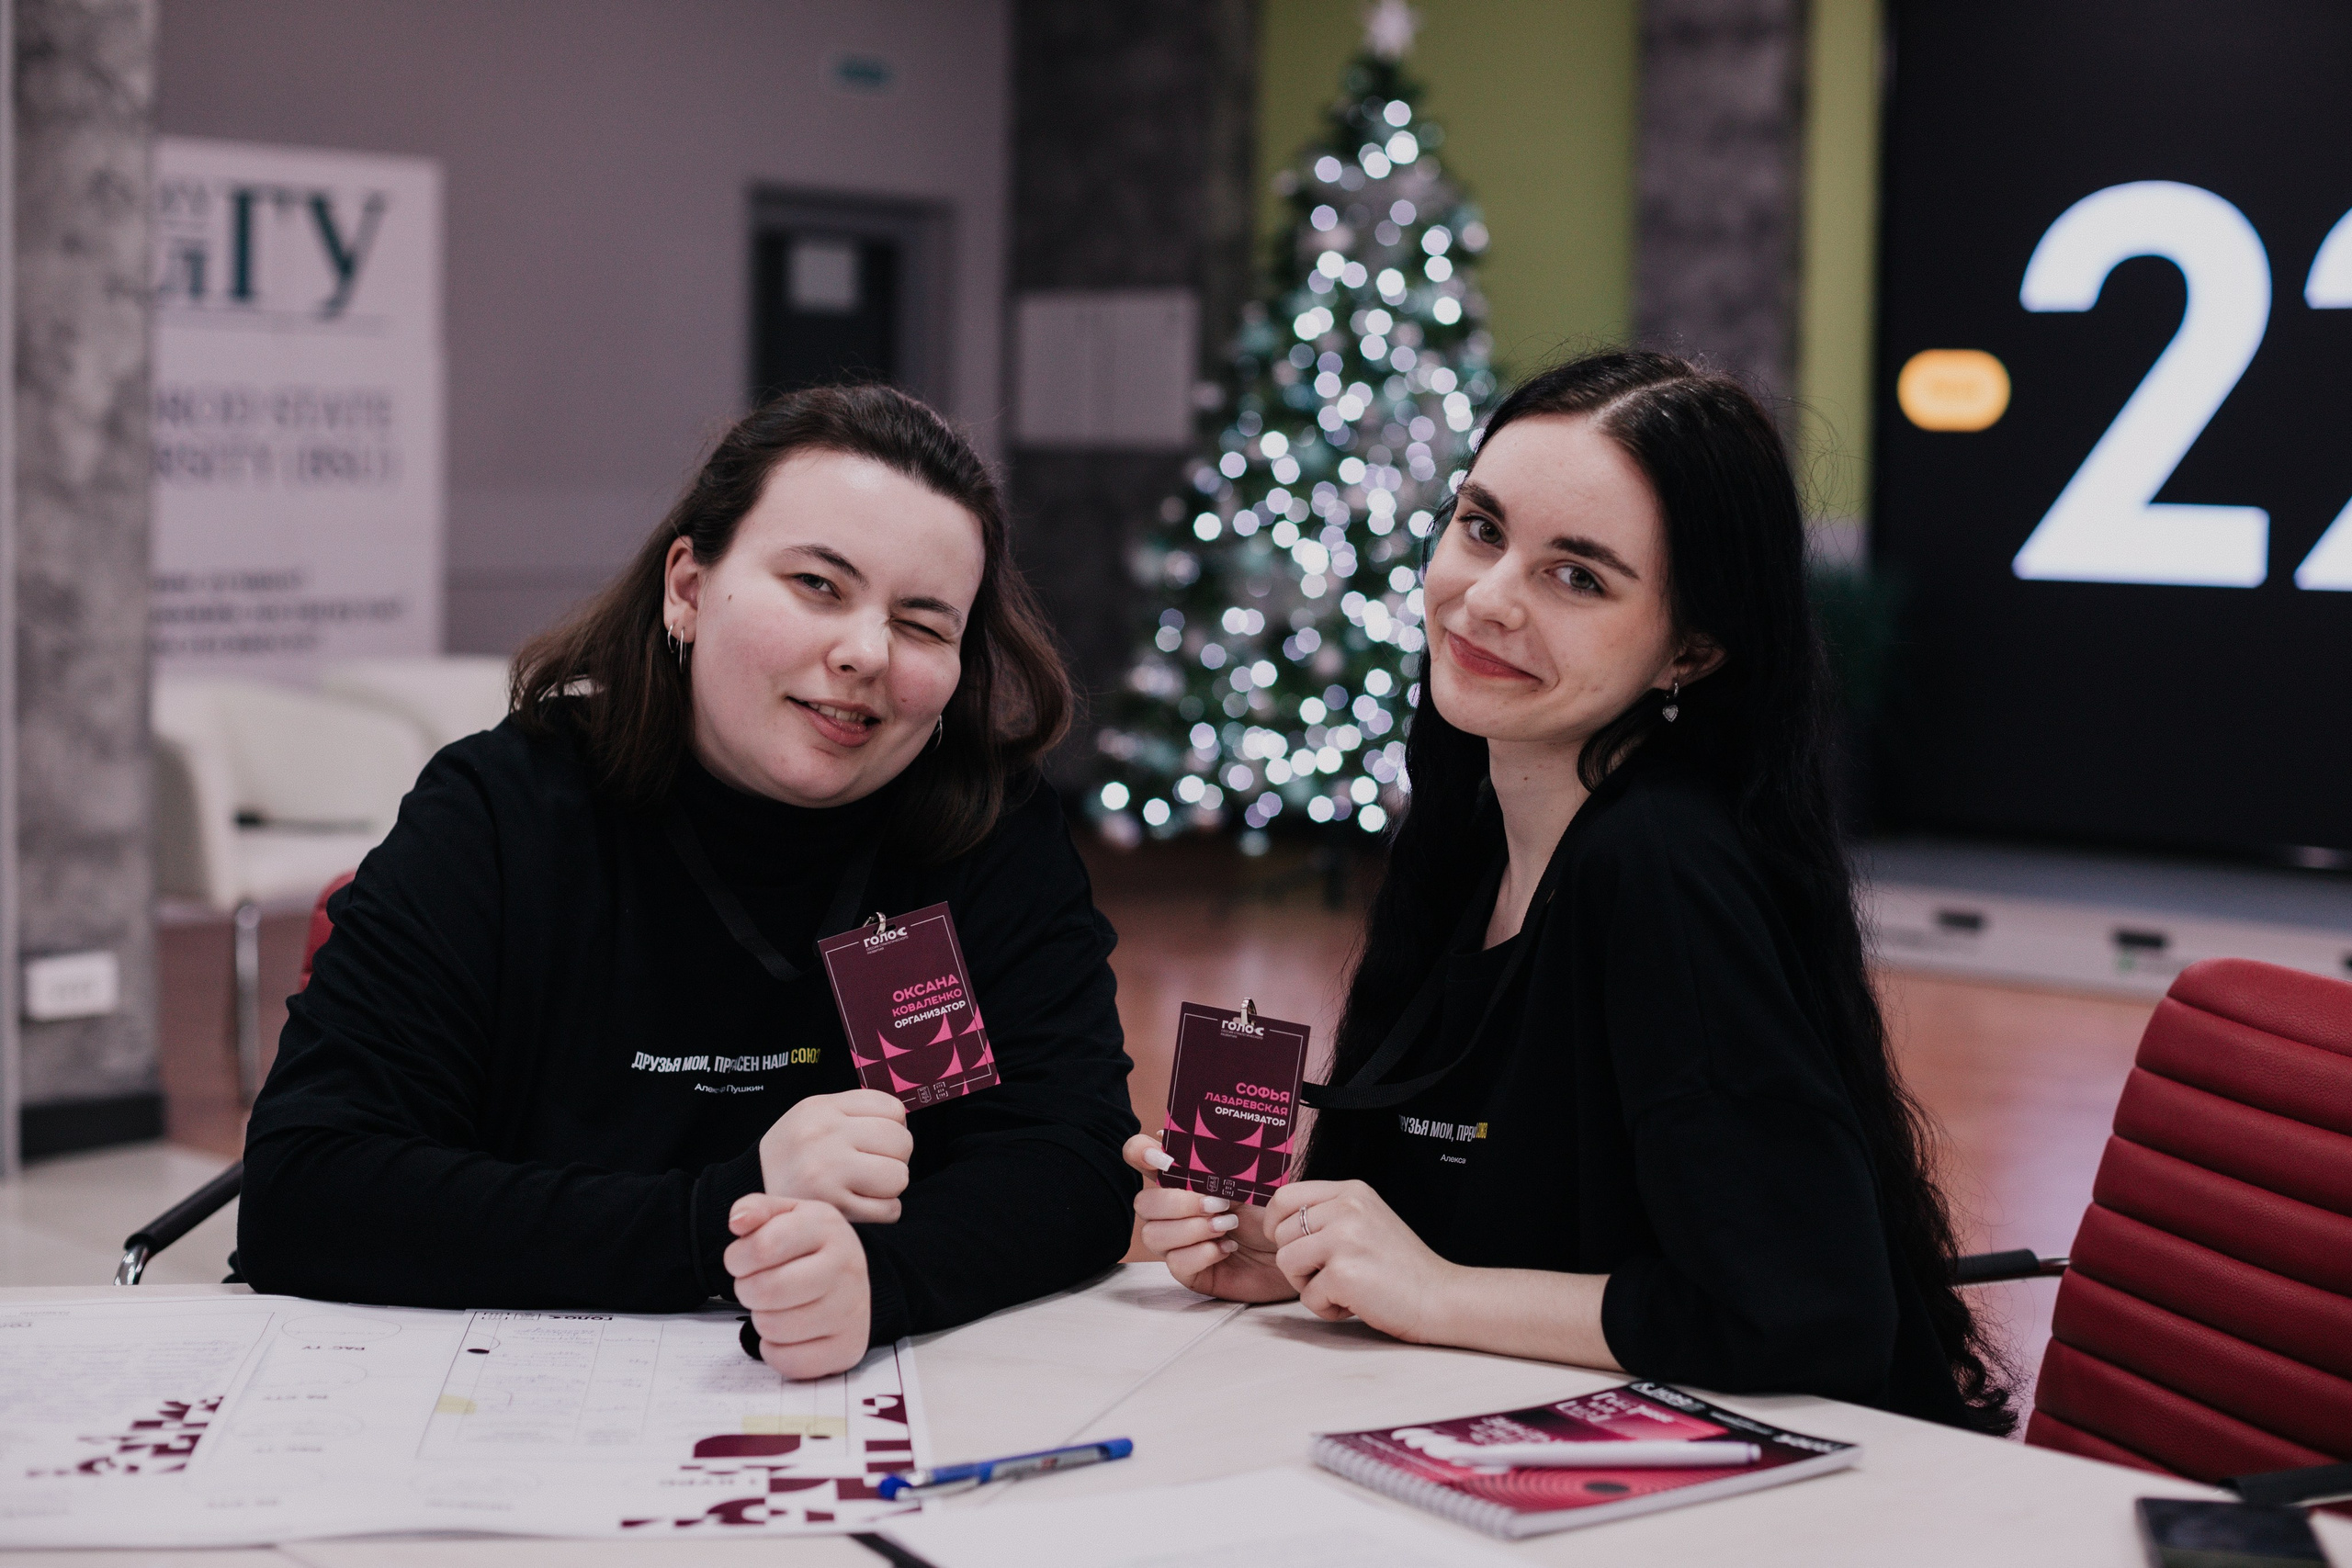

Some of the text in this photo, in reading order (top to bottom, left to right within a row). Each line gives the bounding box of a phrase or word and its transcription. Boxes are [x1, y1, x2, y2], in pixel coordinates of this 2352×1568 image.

[2012, 180, 2352, 592] 2
[892, 974, 959, 1002] ОКСАНА
[892, 988, 962, 1017] КОВАЛЕНКО
[894, 1000, 966, 1029] ОРГАНИЗАТОР
[631, 1051, 682, 1073] ДРУЗЬЯ
[762, 1051, 789, 1070] НАШ
[726, 1084, 764, 1095] Пушкин
[1236, 1082, 1290, 1103] СОФЬЯ
[1204, 1092, 1288, 1116] ЛАЗАРЕВСКАЯ
[1215, 1106, 1286, 1127] ОРГАНИЗАТОР
